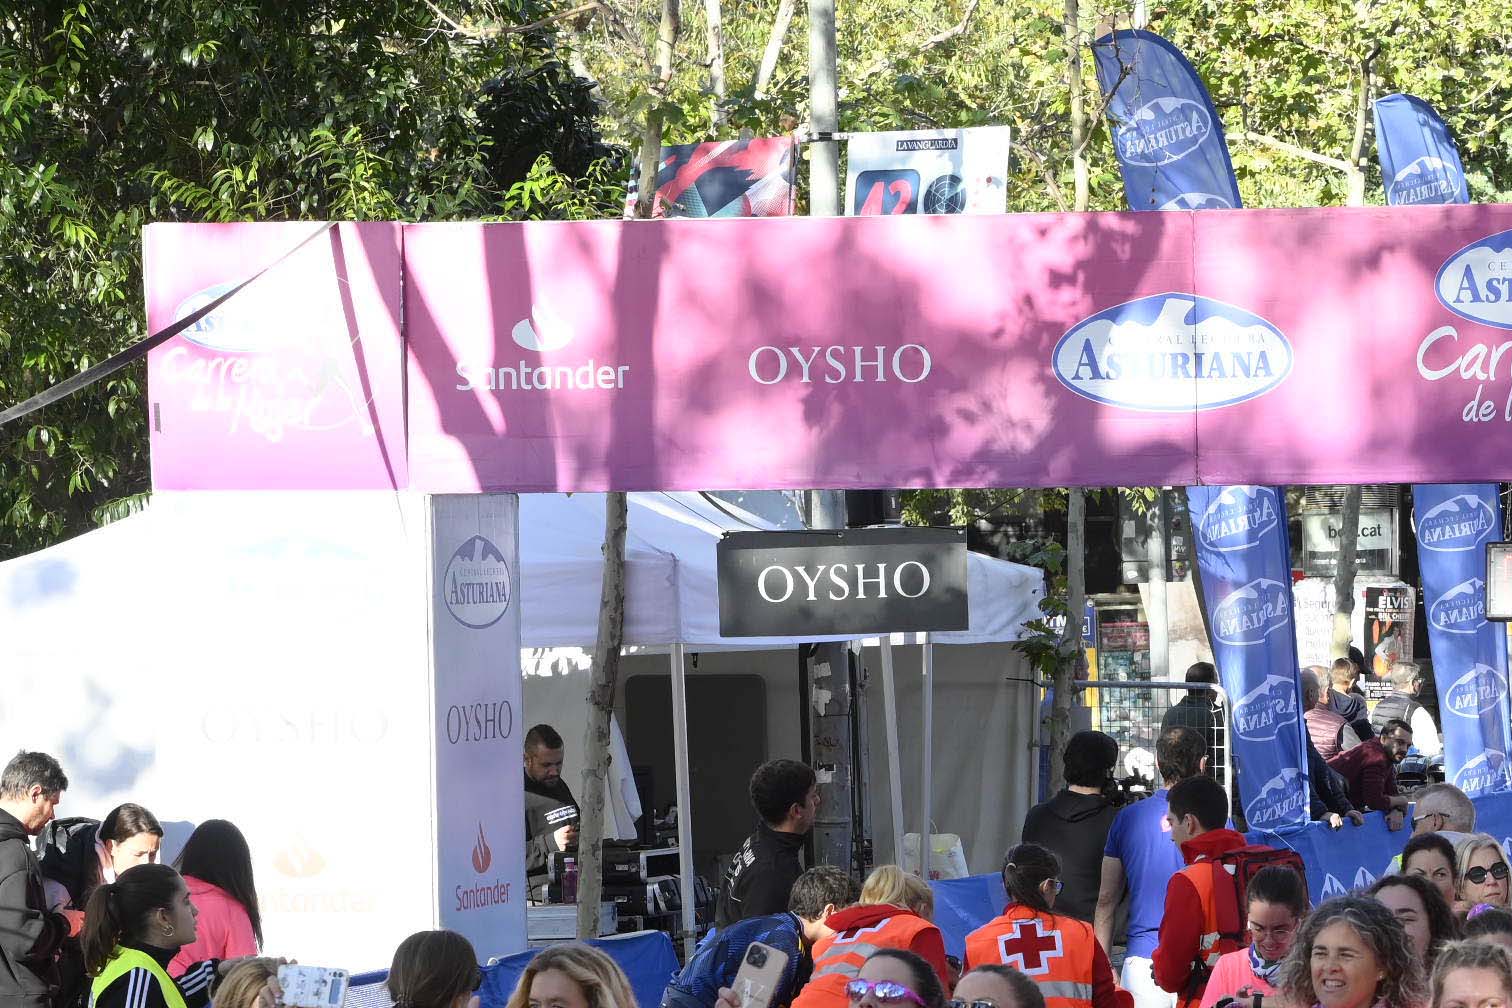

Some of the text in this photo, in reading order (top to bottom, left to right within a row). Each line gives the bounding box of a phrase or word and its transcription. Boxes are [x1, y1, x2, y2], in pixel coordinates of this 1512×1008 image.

[456, 359, 630, 392] Santander
[748, 343, 932, 386] OYSHO
[1462, 385, 1496, 424] de
[450, 571, 507, 606] ASTURIANA
[757, 561, 931, 602] OYSHO
[1378, 596, 1409, 608] ELVIS
[446, 700, 513, 744] OYSHO
[456, 880, 511, 911] Santander
